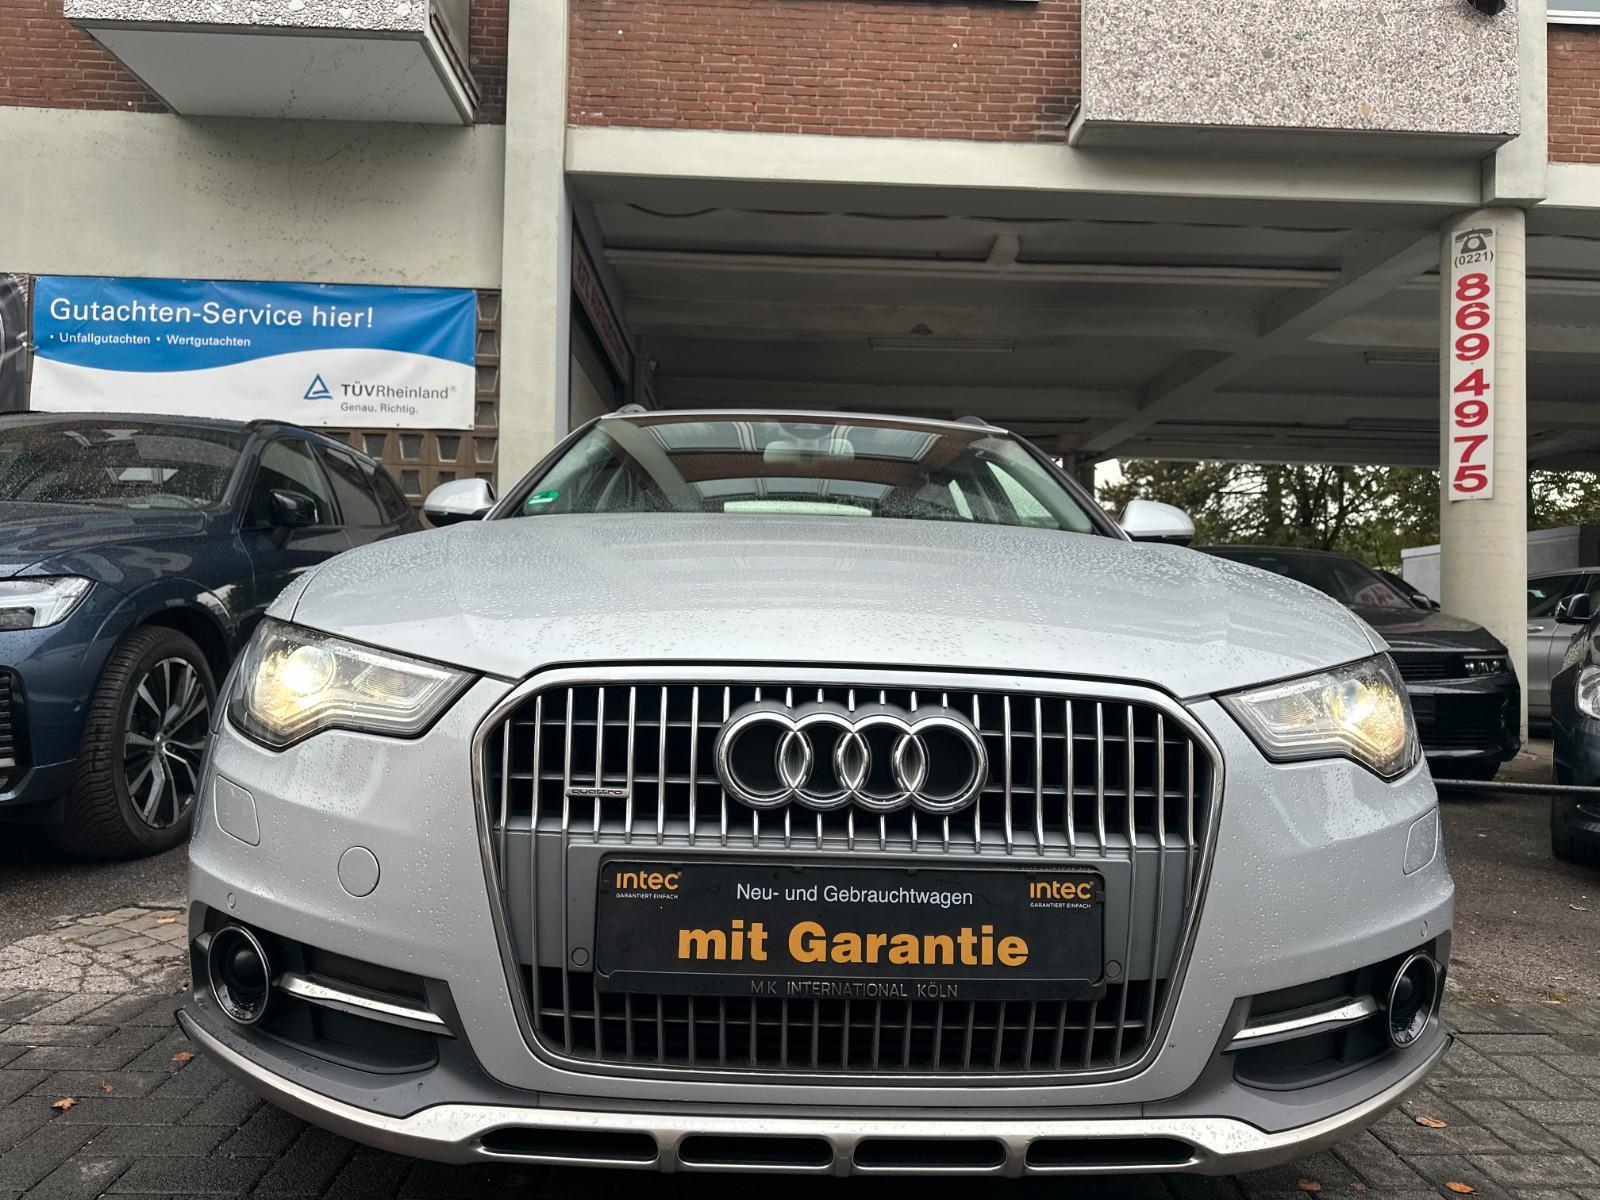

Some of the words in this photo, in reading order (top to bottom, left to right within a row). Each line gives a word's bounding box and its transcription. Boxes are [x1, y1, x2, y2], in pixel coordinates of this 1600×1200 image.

[1454, 250, 1494, 268] (0221)
[50, 298, 302, 327] Gutachten-Service
[312, 306, 374, 328] hier!
[59, 333, 150, 346] Unfallgutachten
[166, 335, 251, 348] Wertgutachten
[340, 402, 377, 413] Genau.
[380, 403, 418, 416] Richtig.
[616, 871, 680, 890] intec
[736, 884, 779, 901] Neu-
[785, 886, 818, 902] und
[823, 886, 973, 908] Gebrauchtwagen
[1030, 881, 1092, 900] intec
[678, 919, 768, 961] mit
[788, 920, 1029, 967] Garantie
[786, 981, 907, 998] INTERNATIONAL
[917, 982, 958, 999] KÖLN
